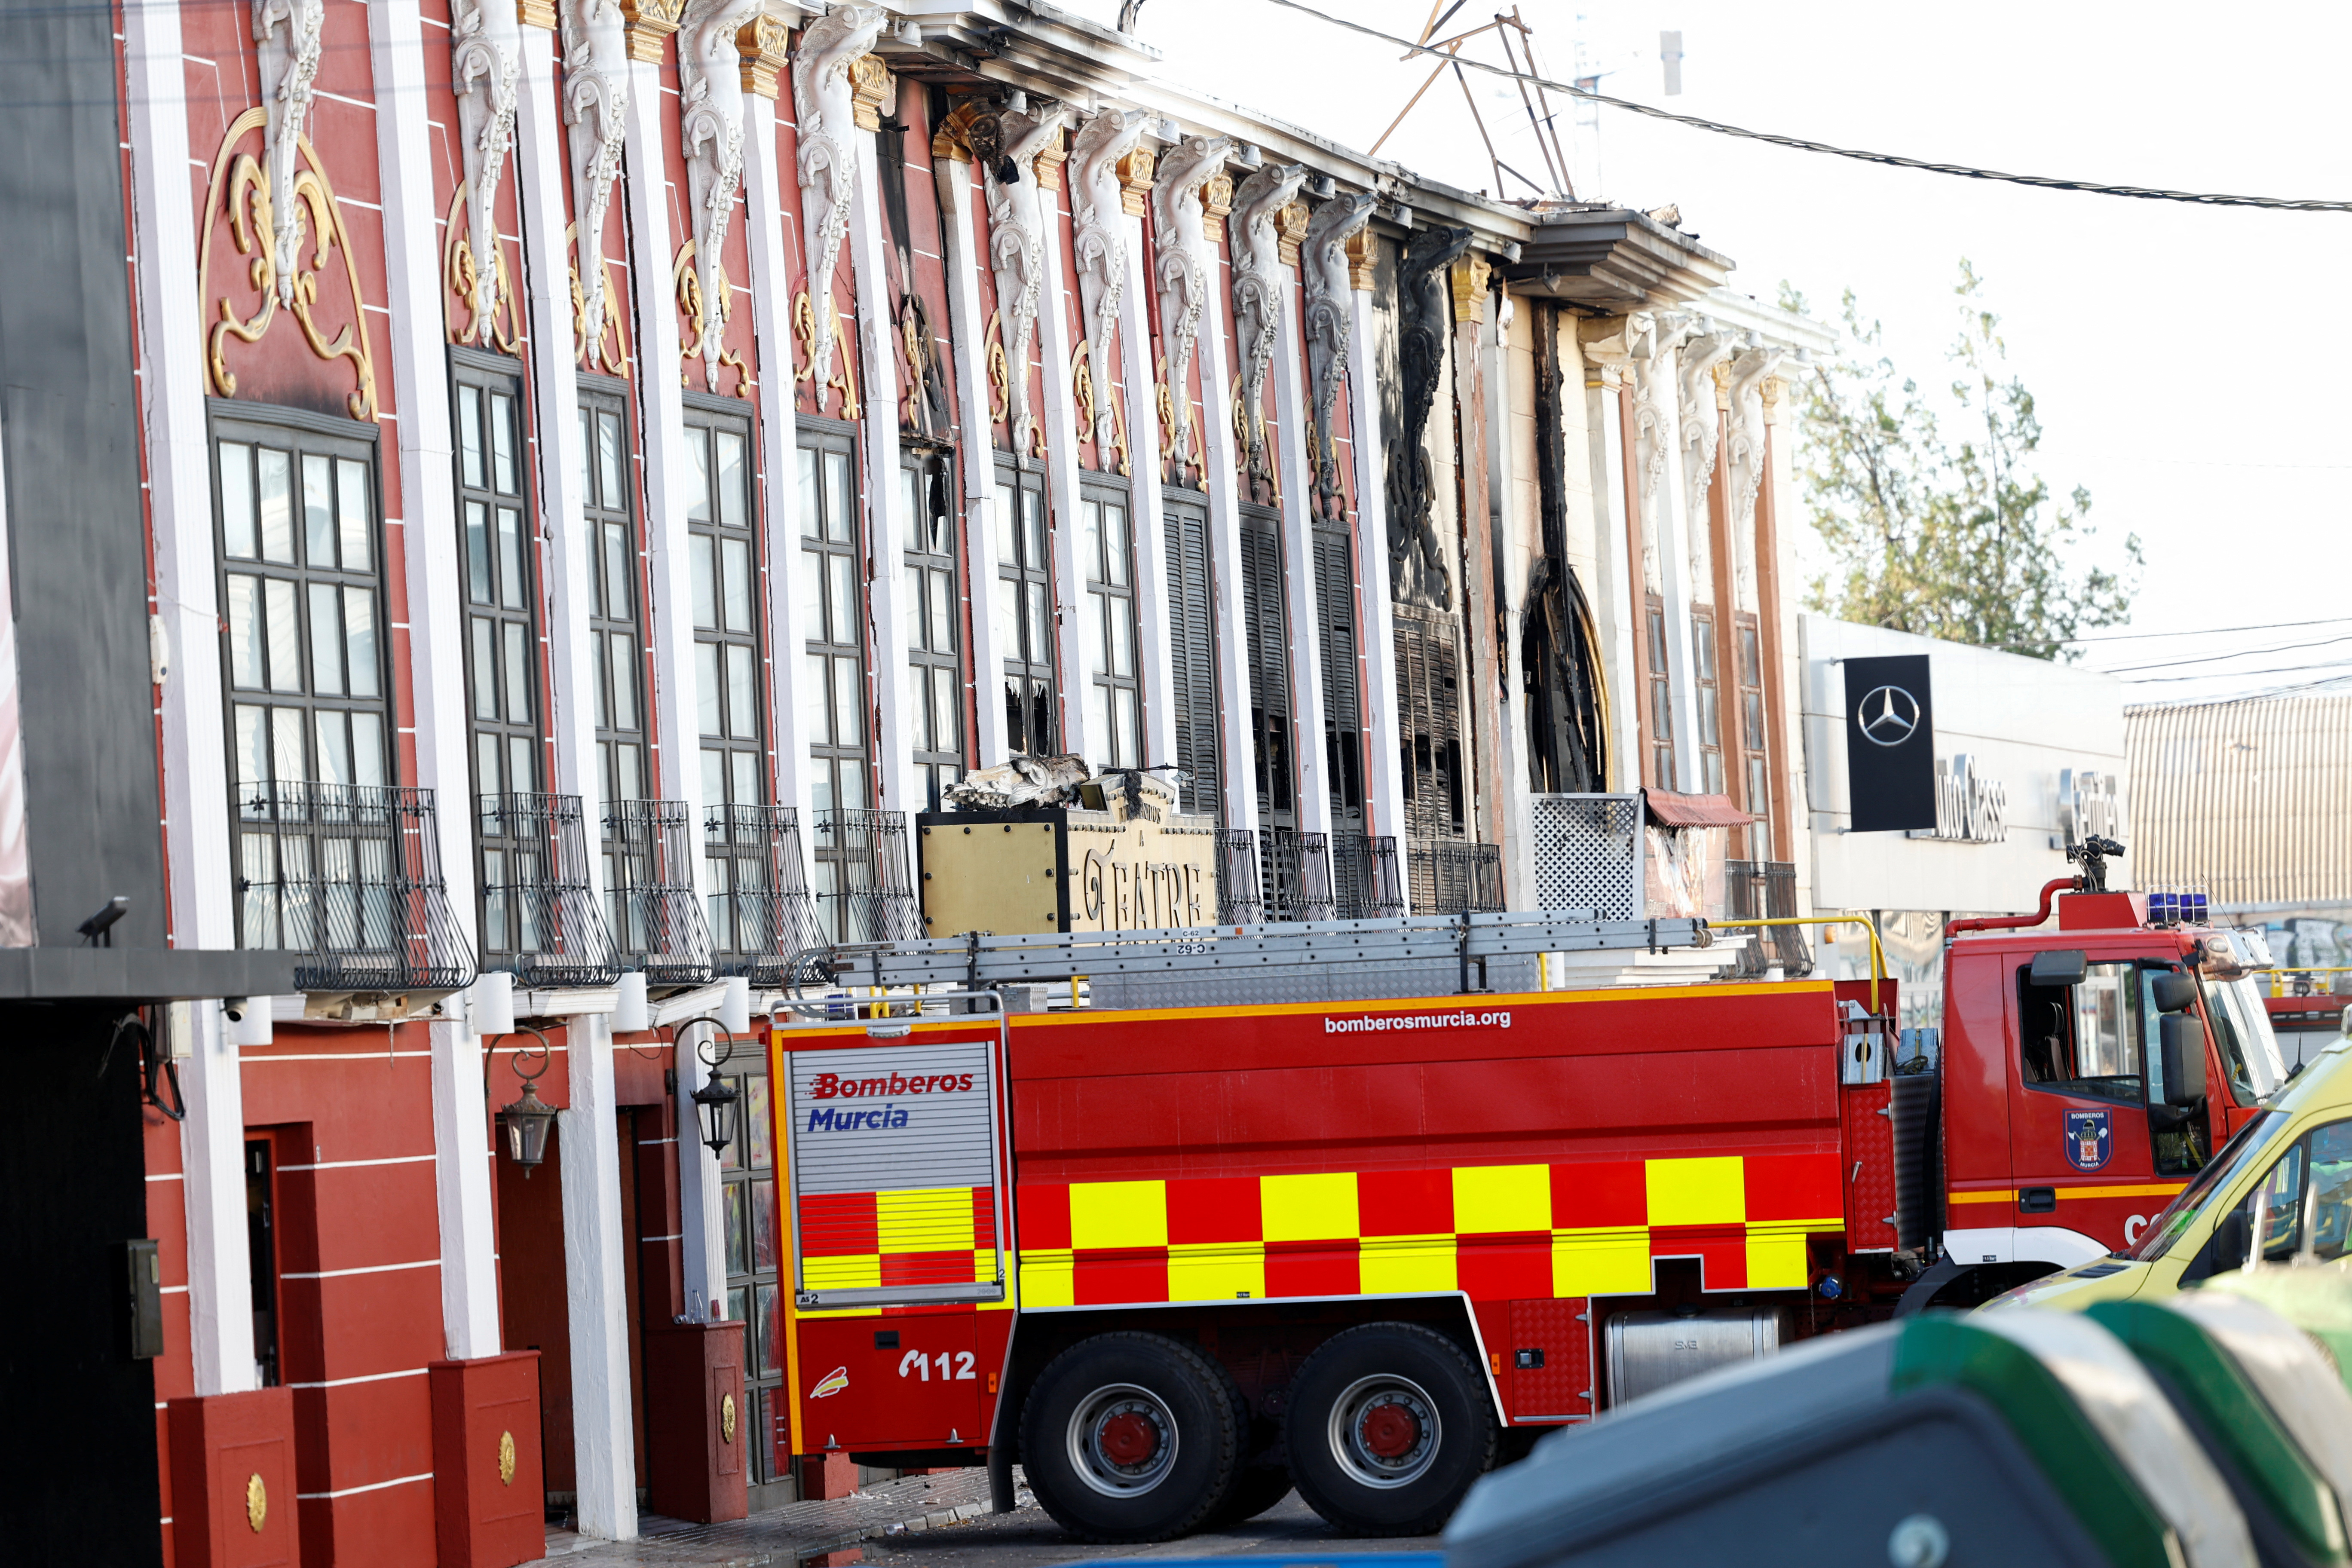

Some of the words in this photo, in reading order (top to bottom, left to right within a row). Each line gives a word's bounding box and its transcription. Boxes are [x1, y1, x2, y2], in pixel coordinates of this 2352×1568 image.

[1084, 839, 1200, 946] TEATRE
[1177, 943, 1205, 954] C-62
[1325, 1010, 1511, 1033] bomberosmurcia.org
[808, 1072, 974, 1099] Bomberos
[808, 1103, 909, 1132] Murcia
[998, 1268, 1005, 1278] 2
[811, 1294, 819, 1304] 2
[914, 1351, 977, 1382] 112
